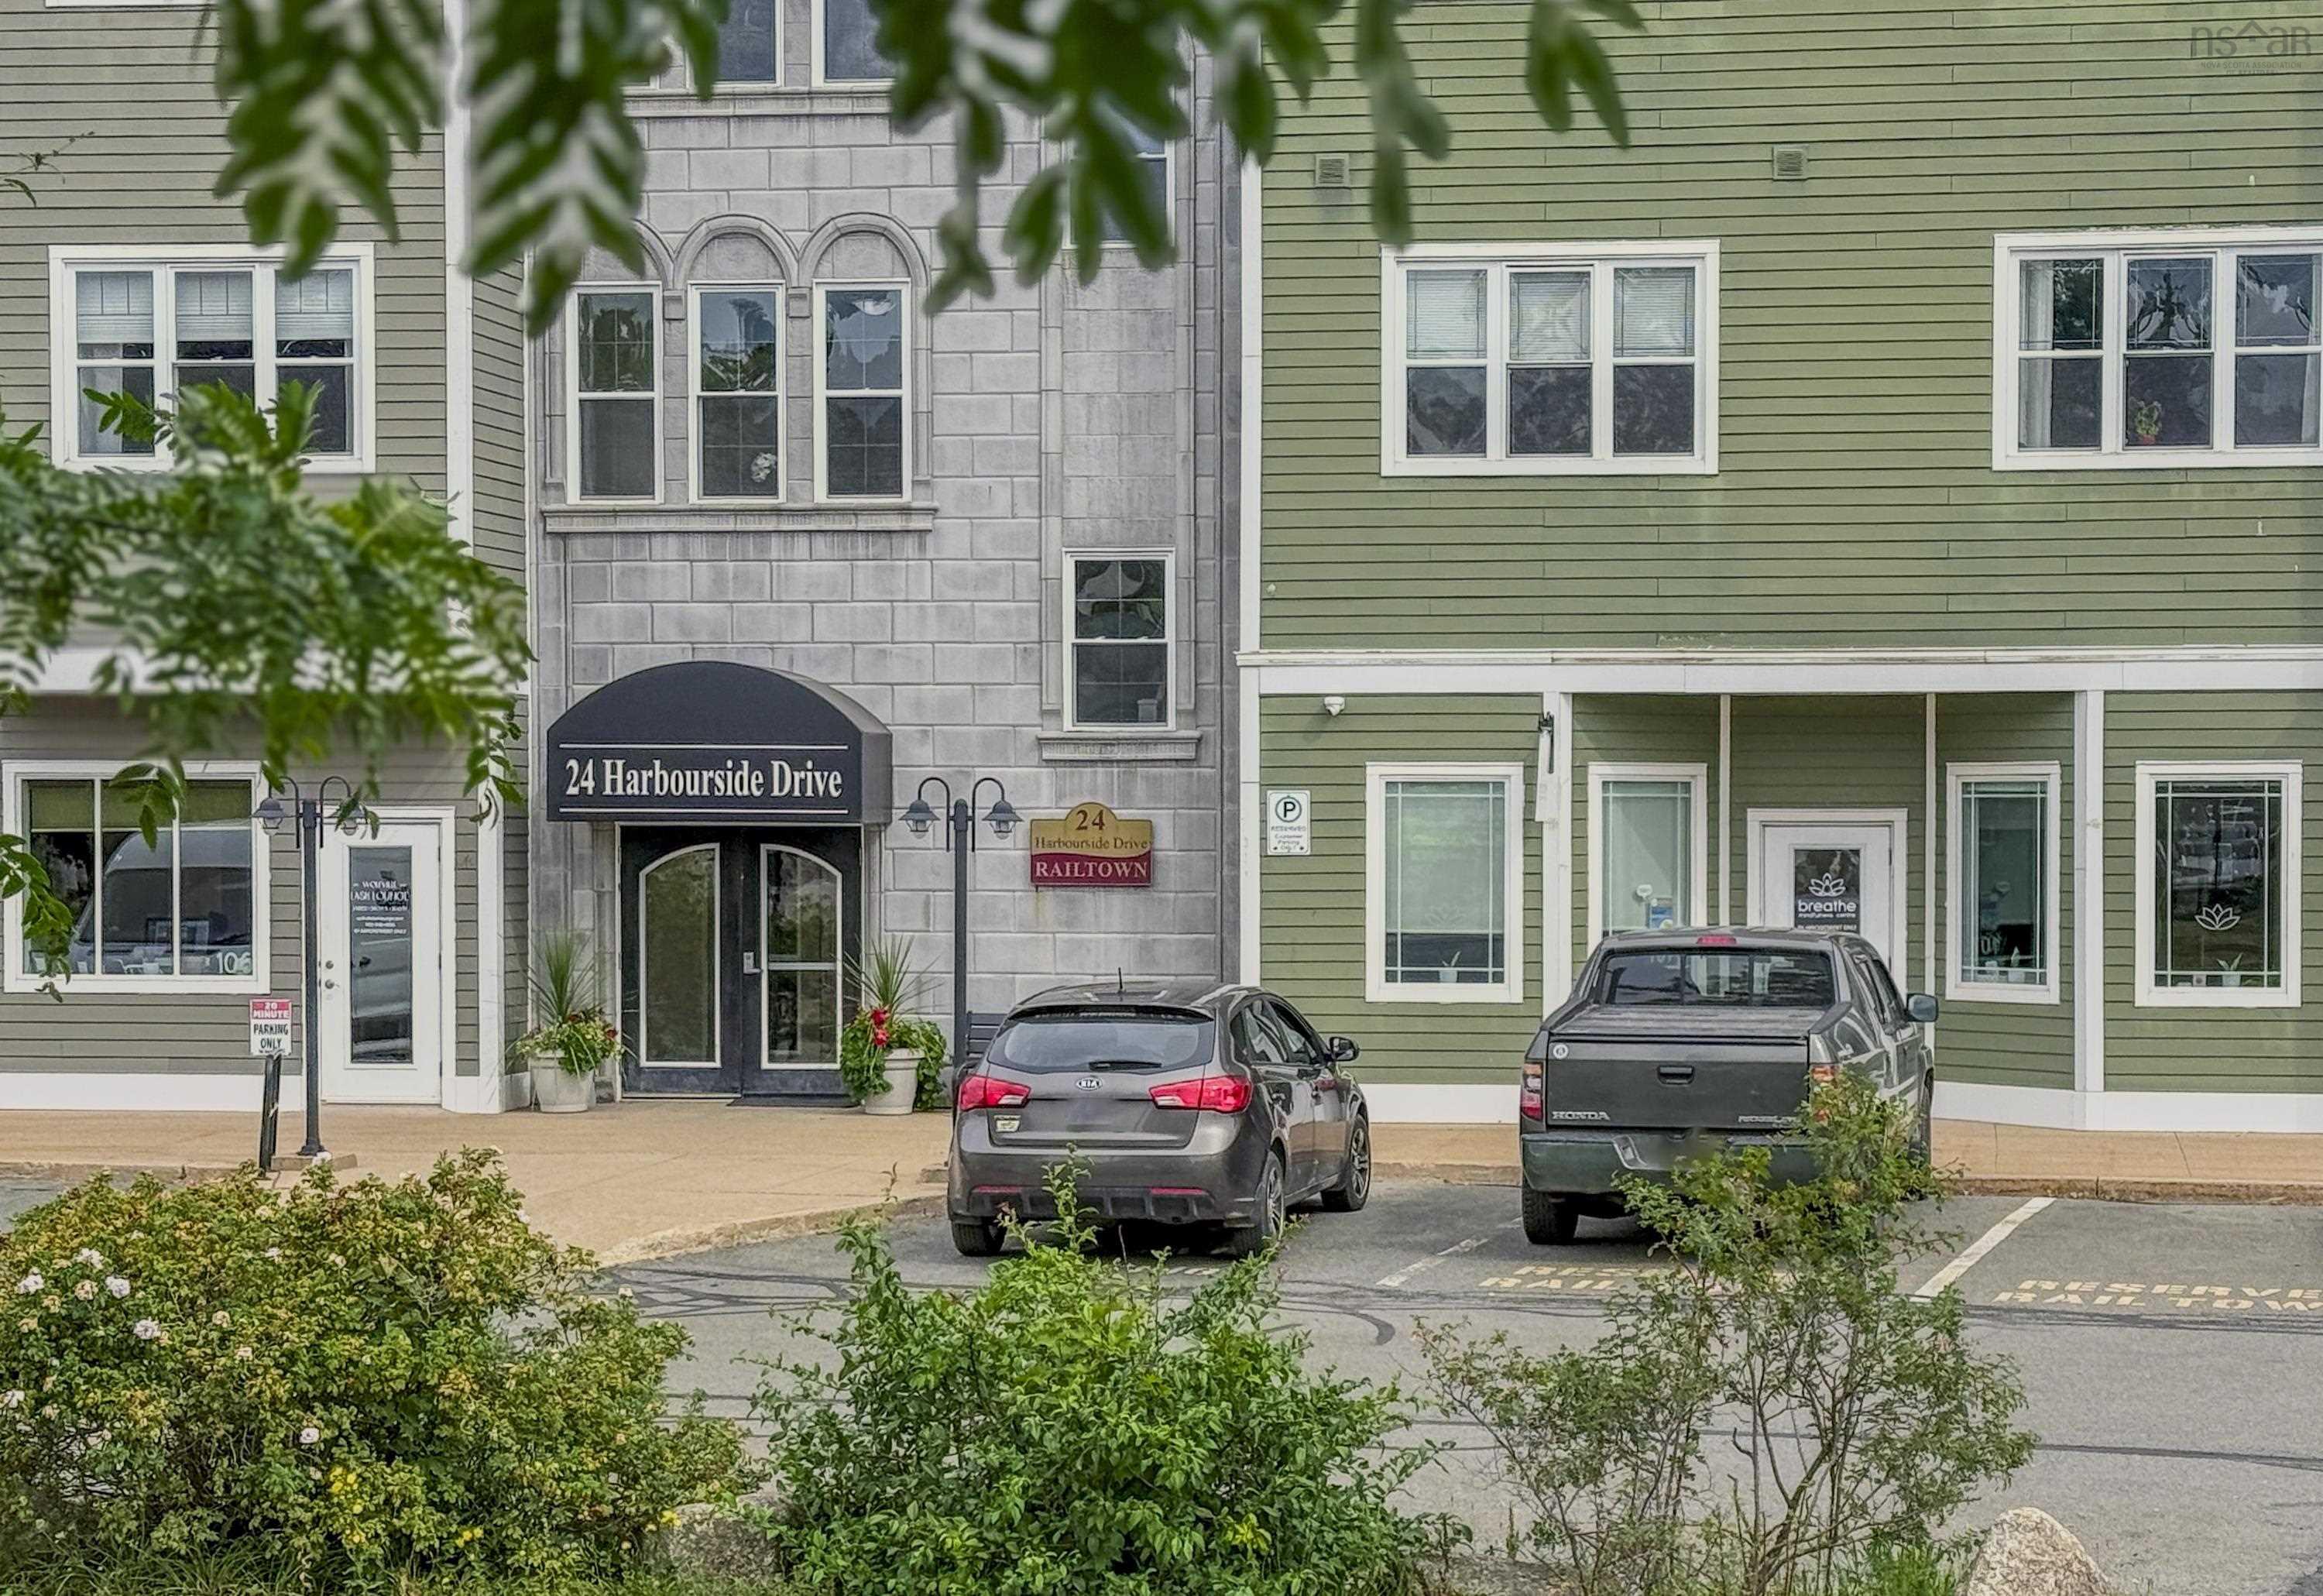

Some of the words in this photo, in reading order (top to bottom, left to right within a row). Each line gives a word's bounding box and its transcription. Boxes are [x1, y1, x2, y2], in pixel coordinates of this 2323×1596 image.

[565, 758, 595, 796] 24
[602, 758, 764, 798] Harbourside
[770, 760, 843, 798] Drive
[1284, 801, 1295, 818] P
[1076, 809, 1105, 831] 24
[1035, 836, 1110, 849] Harbourside
[1113, 836, 1148, 849] Drive
[1035, 861, 1148, 878] RAILTOWN
[1798, 899, 1857, 912] breathe
[253, 1010, 290, 1018] MINUTE
[253, 1023, 288, 1035] PARKING
[260, 1038, 282, 1050] ONLY
[1552, 1111, 1611, 1121] HONDA
[1991, 1292, 2146, 1307] RAIL
